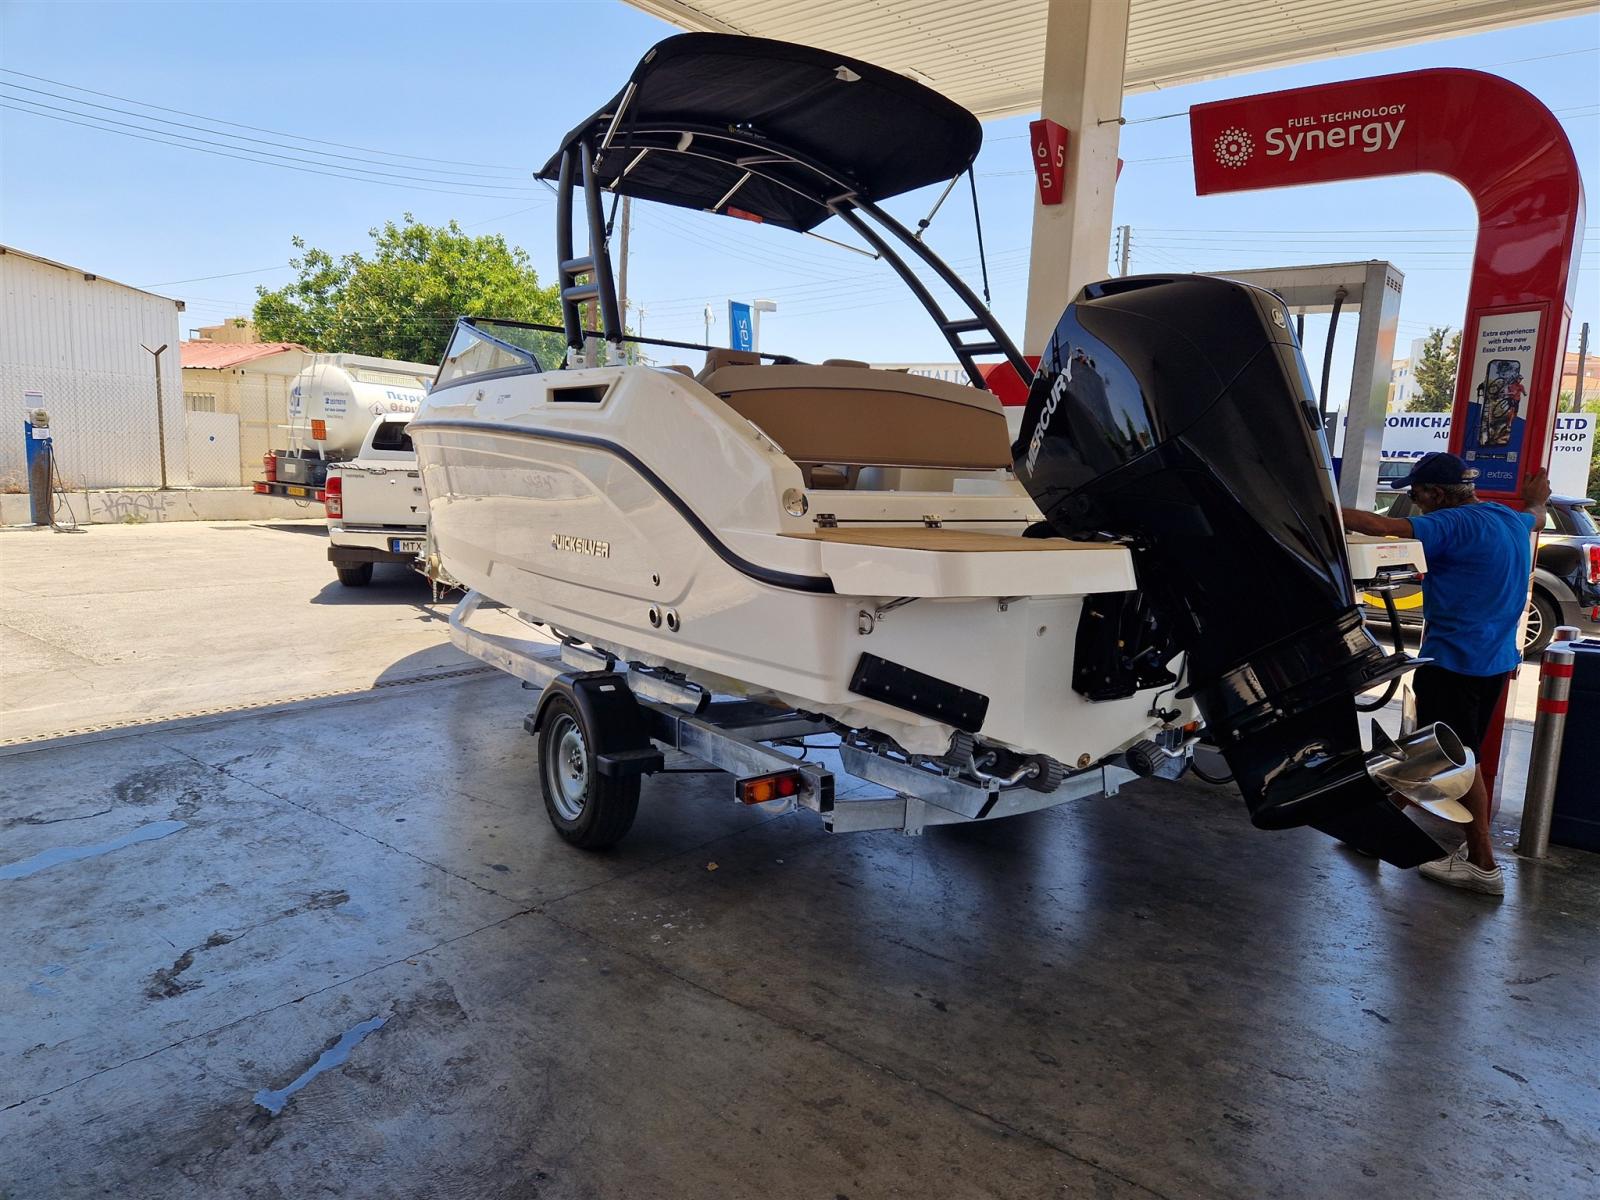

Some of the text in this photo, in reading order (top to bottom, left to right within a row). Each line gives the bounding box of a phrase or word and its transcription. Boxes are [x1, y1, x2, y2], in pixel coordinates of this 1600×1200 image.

[1288, 104, 1406, 127] FUEL TECHNOLOGY
[1265, 120, 1406, 161] Synergy
[1056, 145, 1064, 167] 5
[1499, 328, 1536, 336] experiences
[1025, 355, 1072, 479] MERCURY
[1555, 418, 1588, 429] LTD
[1553, 433, 1586, 441] SHOP
[1487, 470, 1513, 479] extras
[402, 542, 422, 551] MTX
